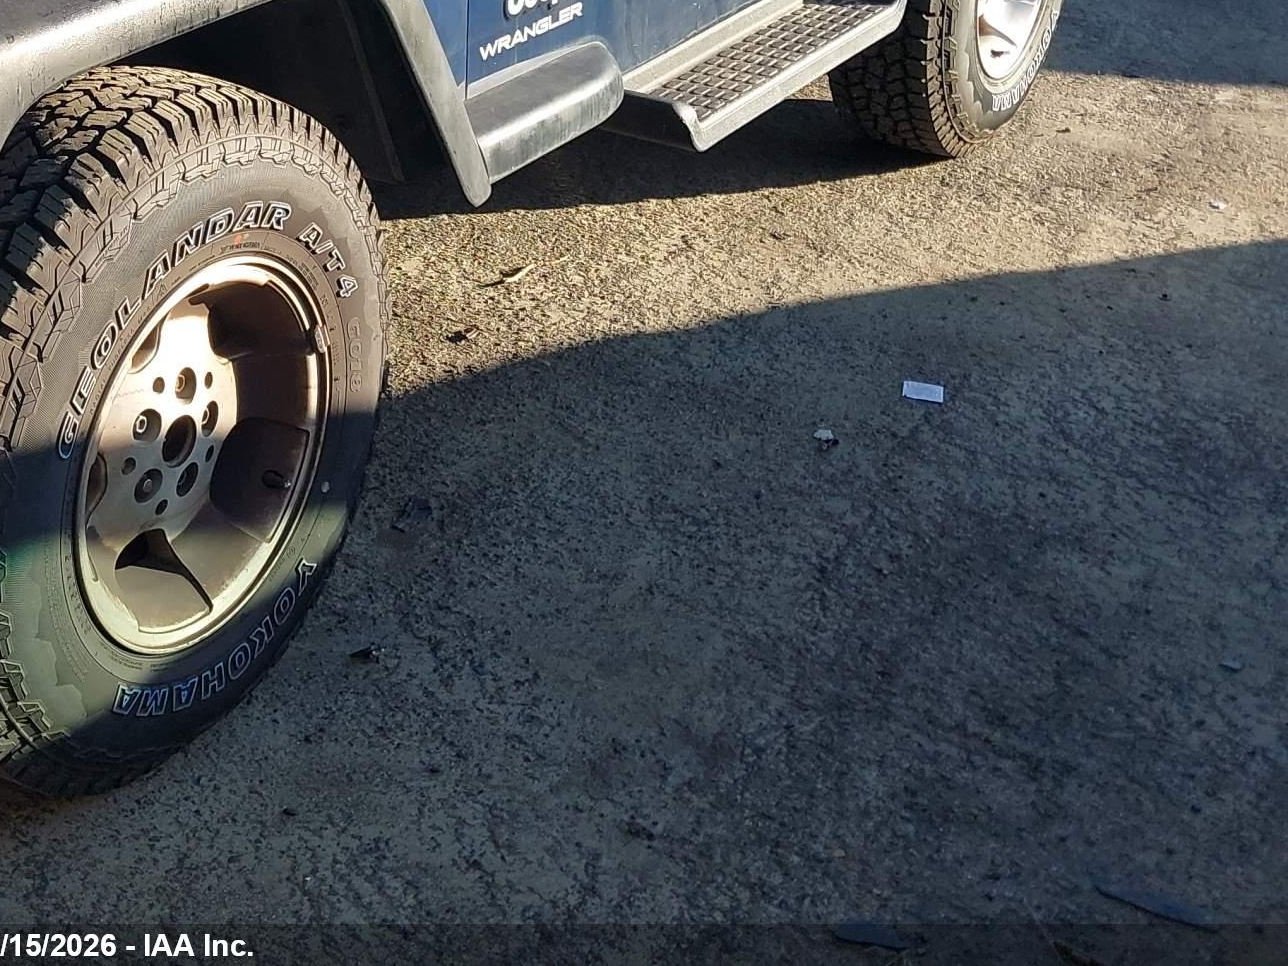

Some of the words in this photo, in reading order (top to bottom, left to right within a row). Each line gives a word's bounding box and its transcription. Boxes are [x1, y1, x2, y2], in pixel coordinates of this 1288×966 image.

[479, 1, 583, 60] WRANGLER
[57, 199, 292, 460] GEOLANDAR
[112, 556, 318, 717] YOKOHAMA
